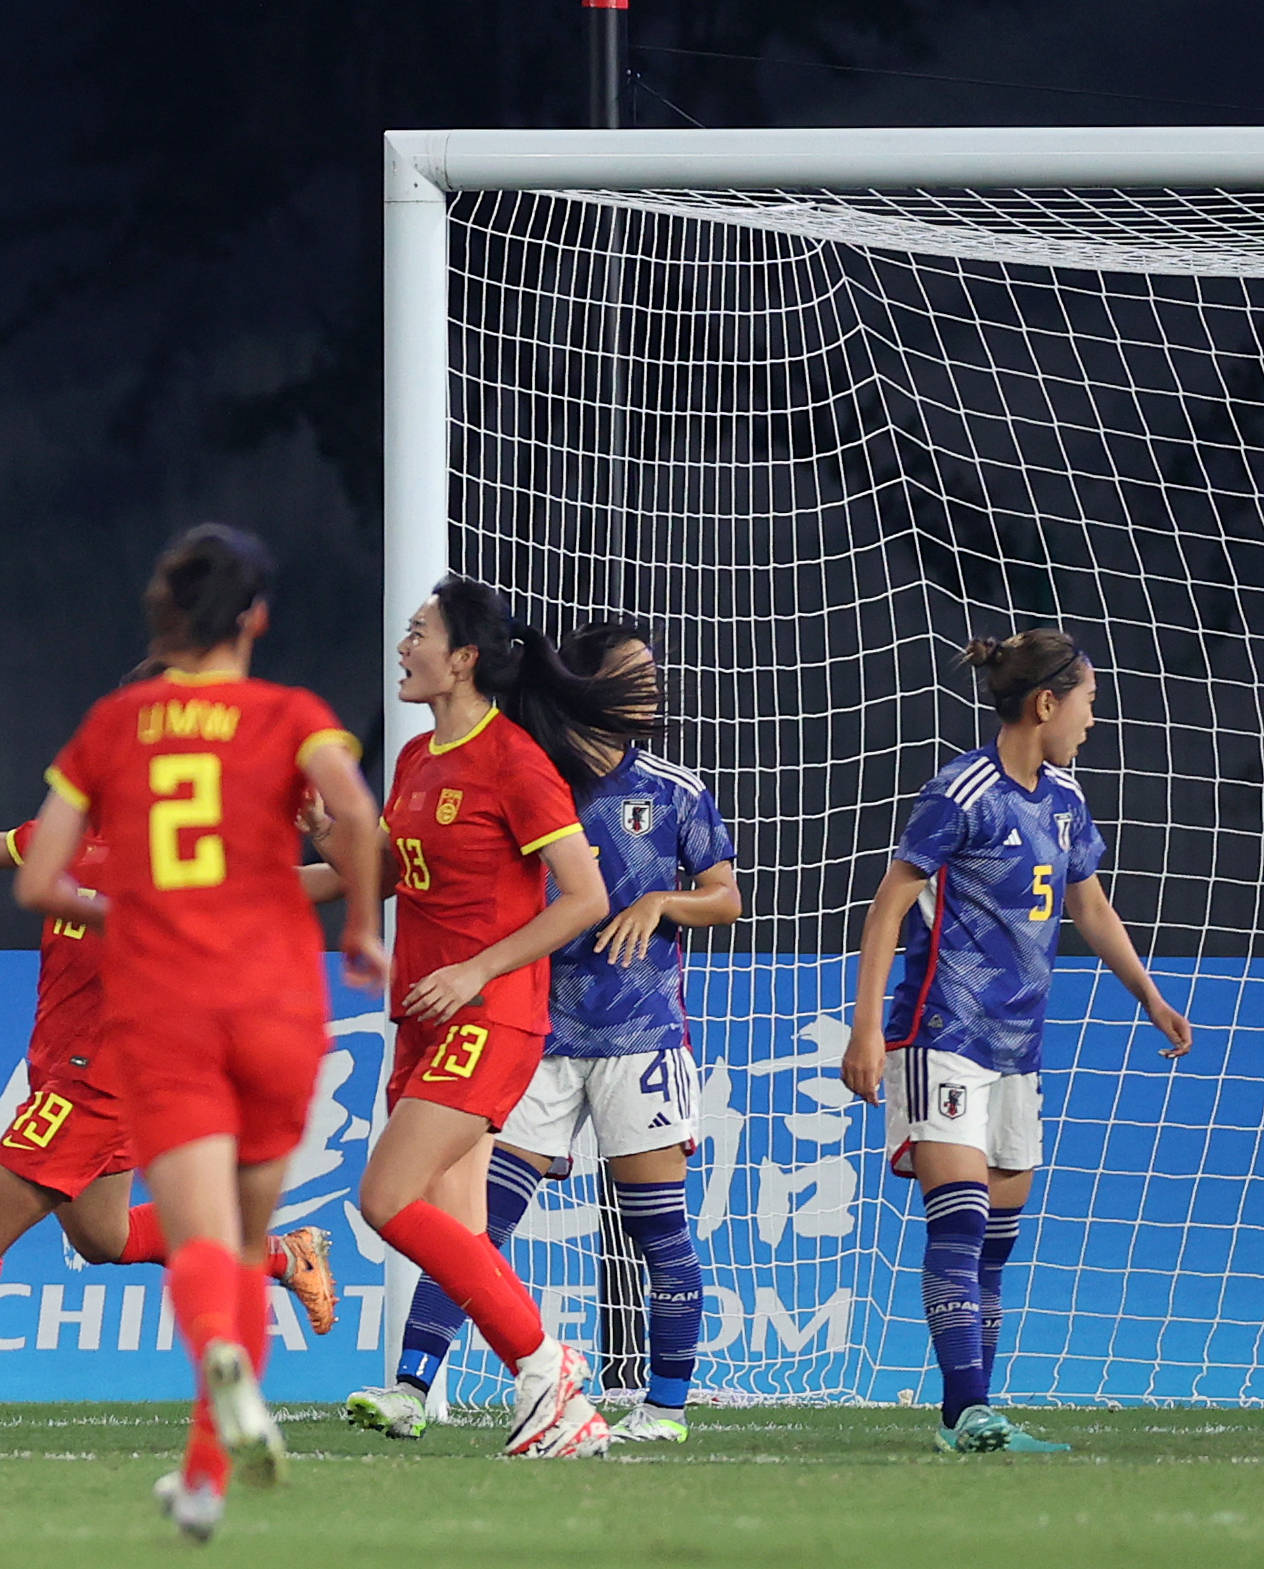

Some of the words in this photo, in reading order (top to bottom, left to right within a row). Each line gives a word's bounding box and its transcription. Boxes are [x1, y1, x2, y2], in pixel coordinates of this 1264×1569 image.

[148, 752, 226, 891] 2
[396, 837, 430, 890] 13
[1029, 864, 1054, 921] 5
[430, 1024, 488, 1078] 13
[639, 1050, 671, 1102] 4
[13, 1091, 74, 1147] 19
